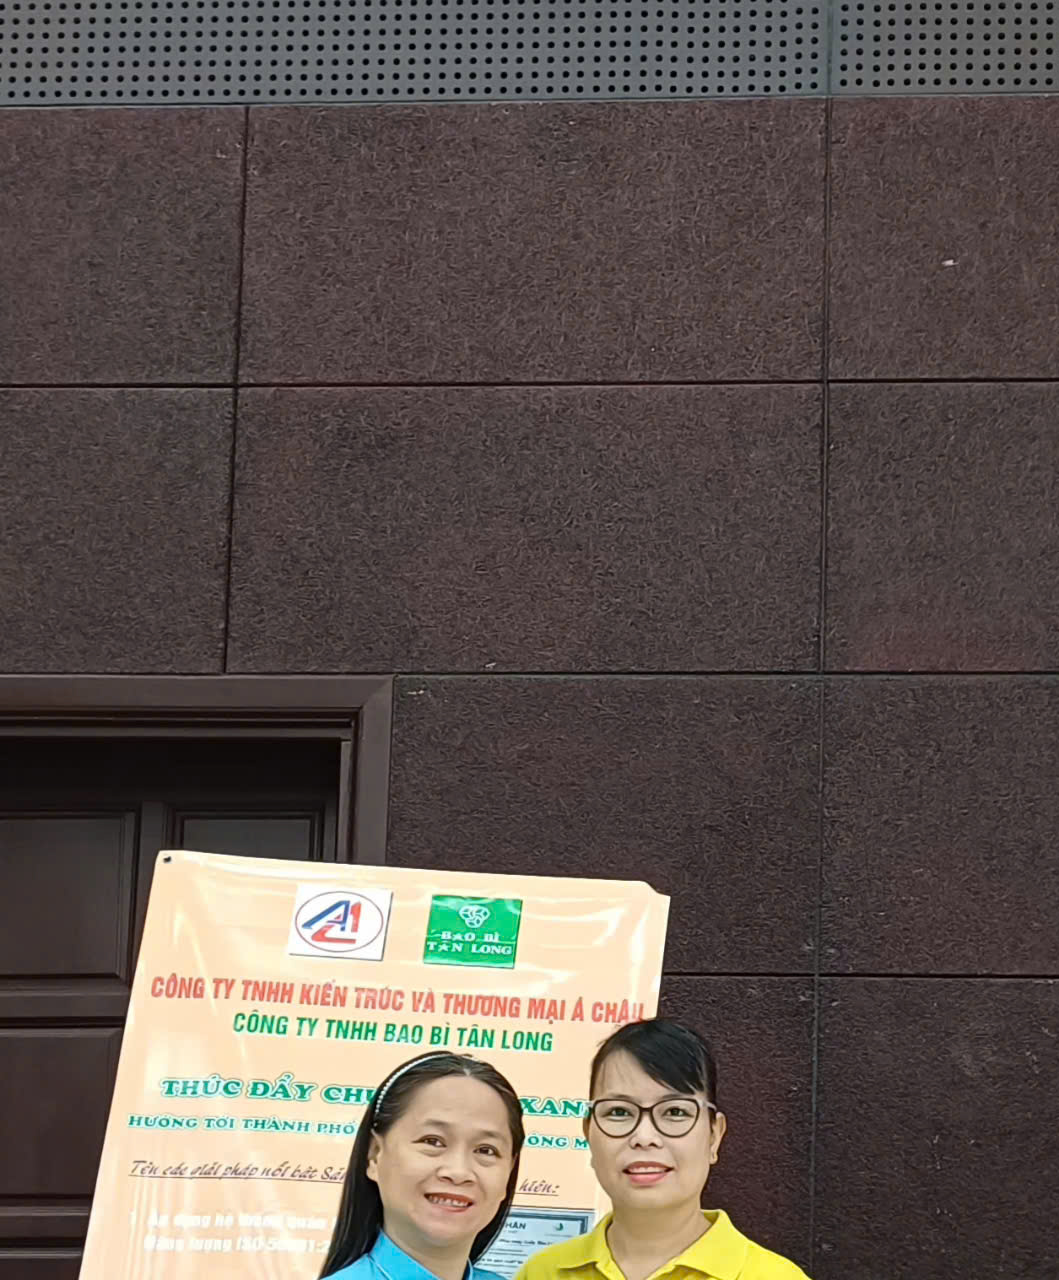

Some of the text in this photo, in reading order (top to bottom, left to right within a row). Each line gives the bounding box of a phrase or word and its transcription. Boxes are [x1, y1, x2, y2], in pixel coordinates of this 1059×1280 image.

[471, 943, 512, 954] LONG
[151, 972, 205, 999] CÔNG
[213, 978, 235, 999] TY
[242, 980, 294, 1004] TNHH
[299, 979, 348, 1008] KIẾN
[354, 985, 405, 1012] TRÚC
[411, 988, 436, 1013] VÀ
[443, 993, 521, 1018] THƯƠNG
[527, 998, 565, 1025] MẠI
[571, 996, 584, 1021] Á
[233, 1010, 553, 1051] CÔNG TY TNHH BAO BÌ TÂN LONG
[162, 1074, 241, 1098] THÚC
[249, 1073, 316, 1100] ĐẨY
[129, 1114, 198, 1129] HƯỚNG
[205, 1115, 235, 1129] TỚI
[243, 1117, 310, 1132] THÀNH
[317, 1120, 356, 1135] PHỐ
[527, 1131, 569, 1147] ÔNG
[131, 1159, 159, 1176] Tên
[161, 1161, 188, 1176] các
[221, 1161, 258, 1179] pháp
